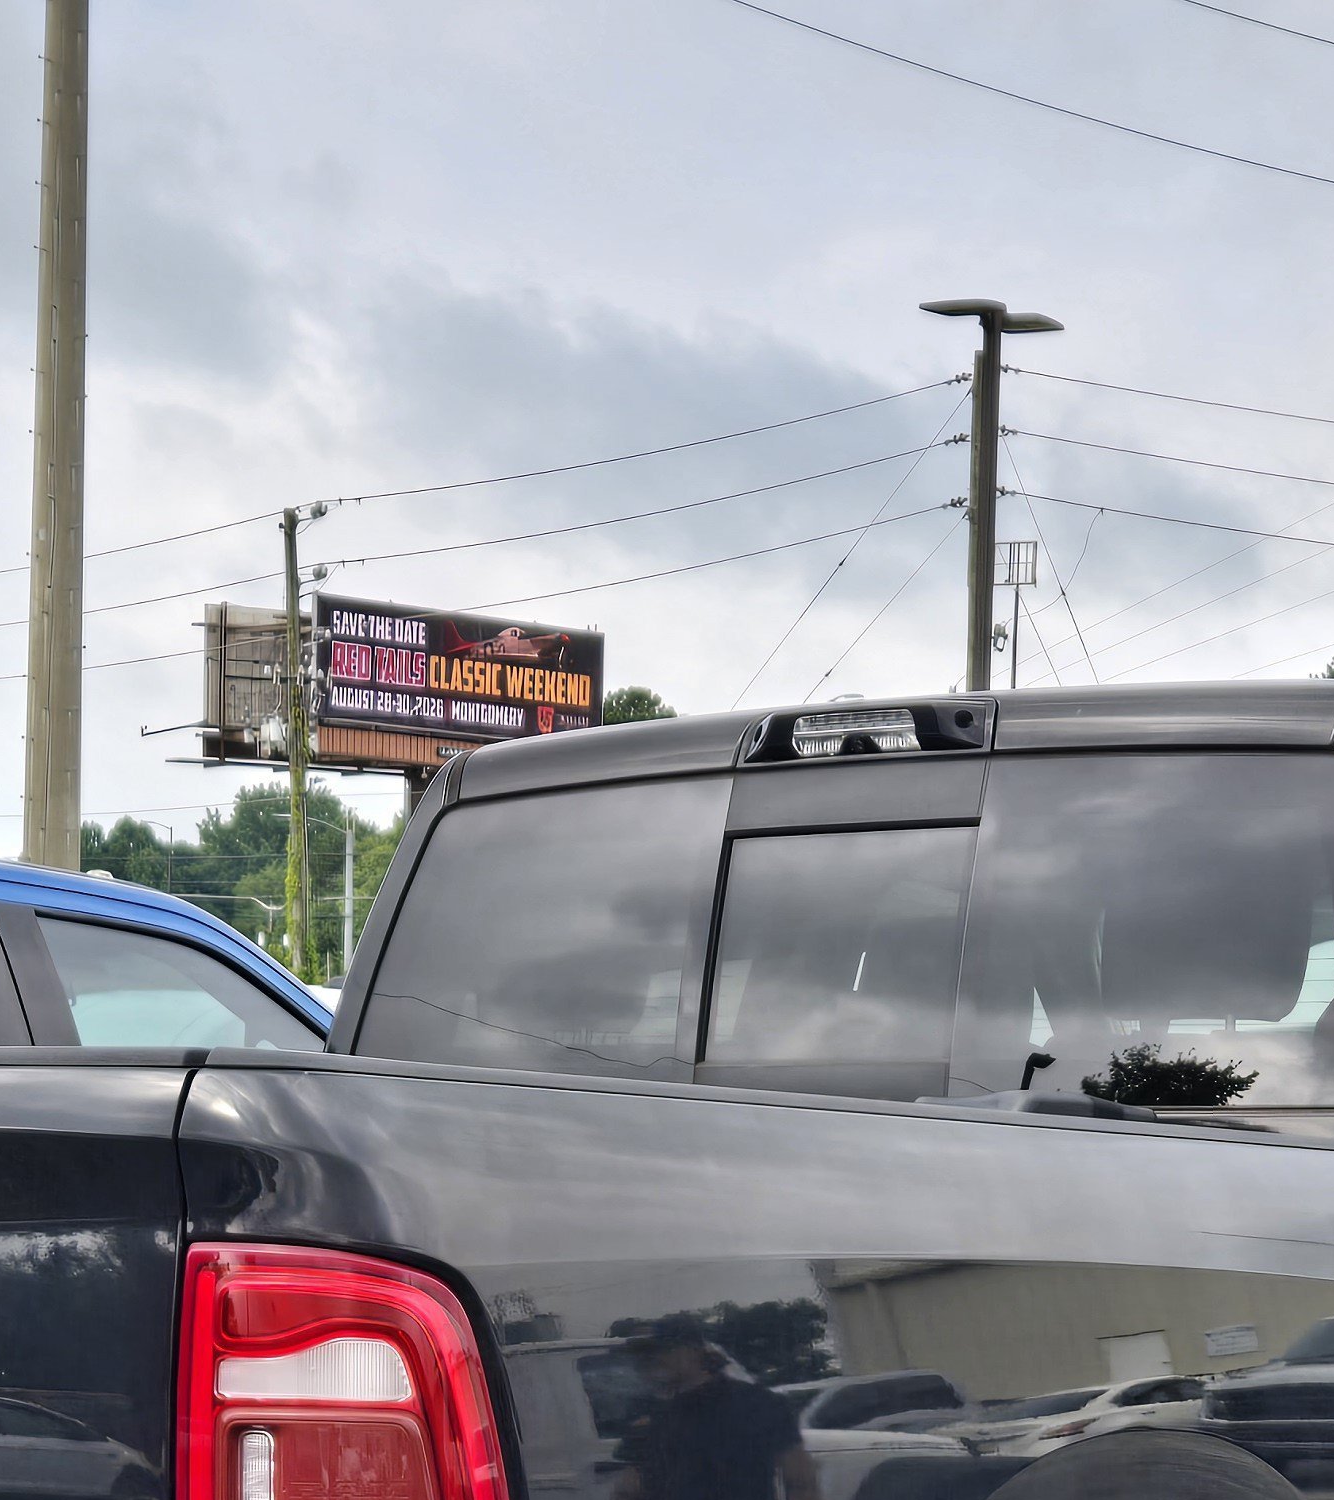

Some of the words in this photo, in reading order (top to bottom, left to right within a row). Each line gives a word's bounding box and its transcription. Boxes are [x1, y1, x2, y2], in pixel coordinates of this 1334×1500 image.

[333, 611, 365, 636] SAVE
[368, 615, 392, 640] THE
[395, 619, 426, 644] DATE
[331, 640, 372, 680] RED
[375, 646, 426, 687] TAILS
[429, 655, 502, 696] CLASSIC
[506, 665, 591, 707] WEEKEND
[331, 686, 374, 711] AUGUST
[451, 700, 524, 727] MONTGOMERY
